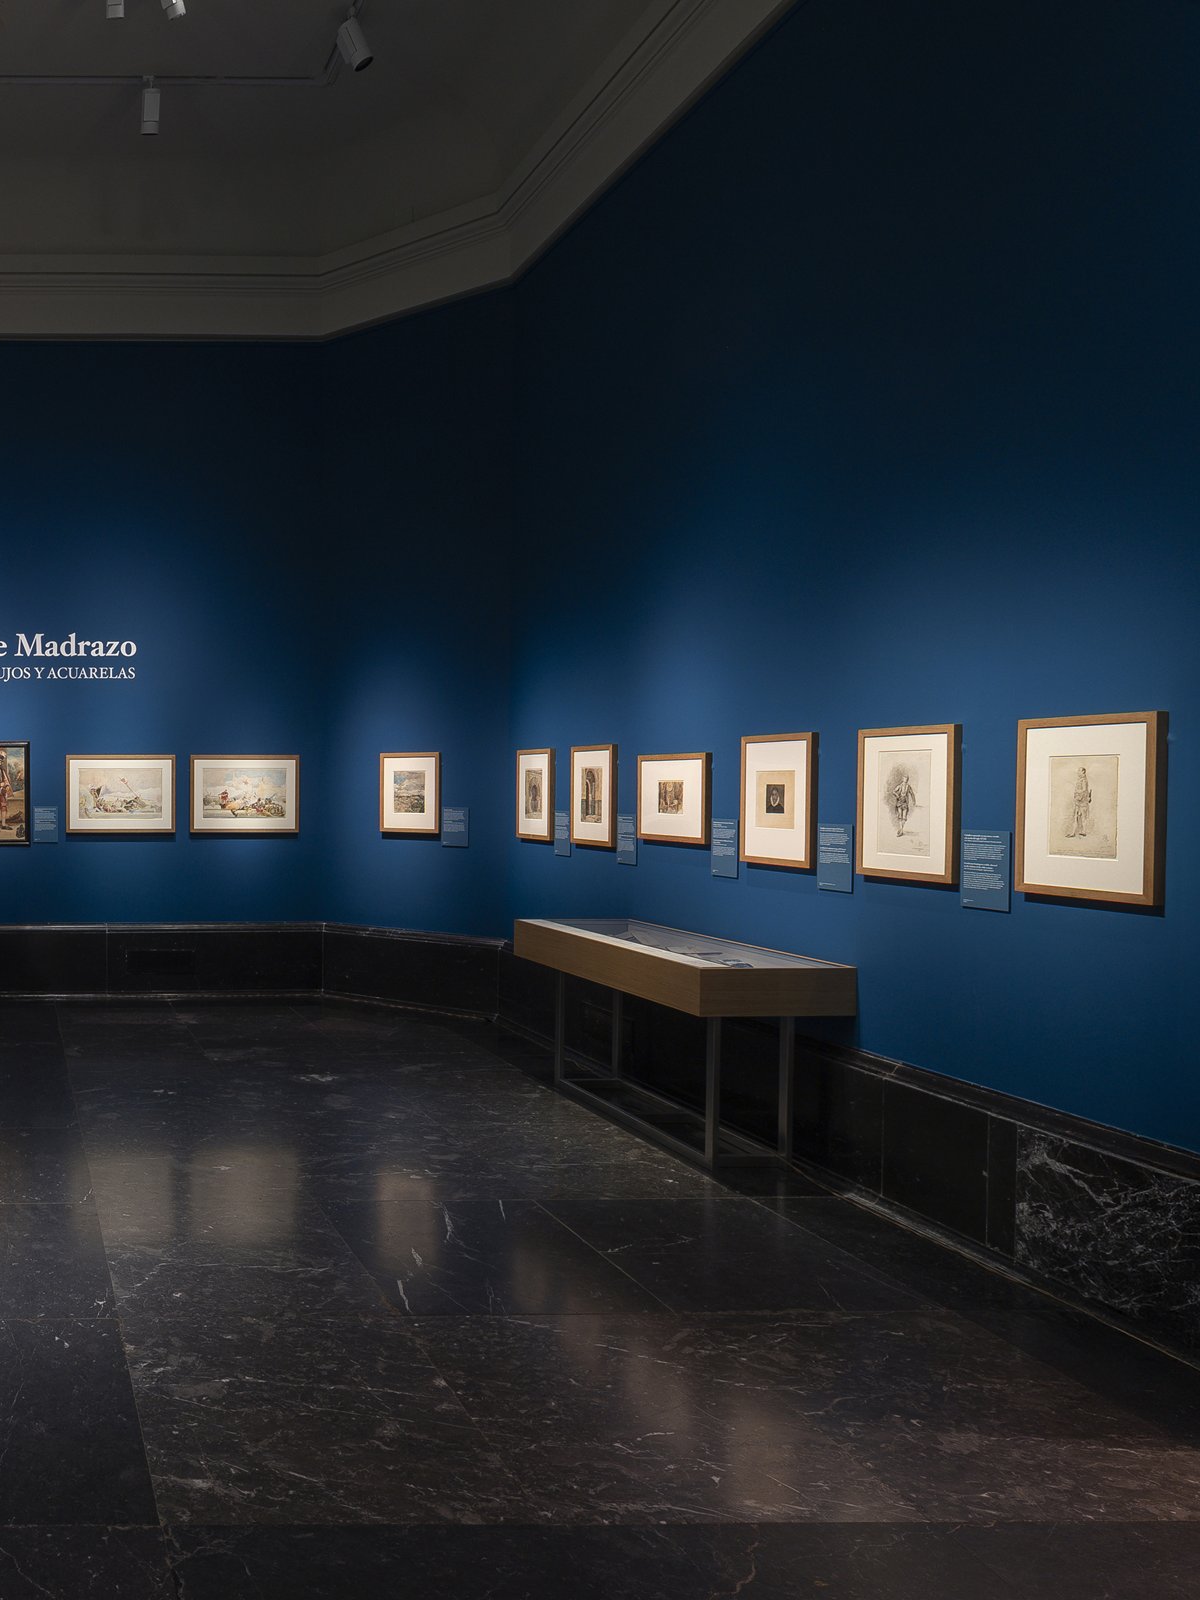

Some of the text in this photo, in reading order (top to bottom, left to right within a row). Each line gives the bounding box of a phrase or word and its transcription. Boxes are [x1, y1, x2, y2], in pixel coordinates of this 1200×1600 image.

[14, 633, 136, 656] Madrazo
[34, 667, 44, 678] Y
[47, 667, 135, 679] ACUARELAS
